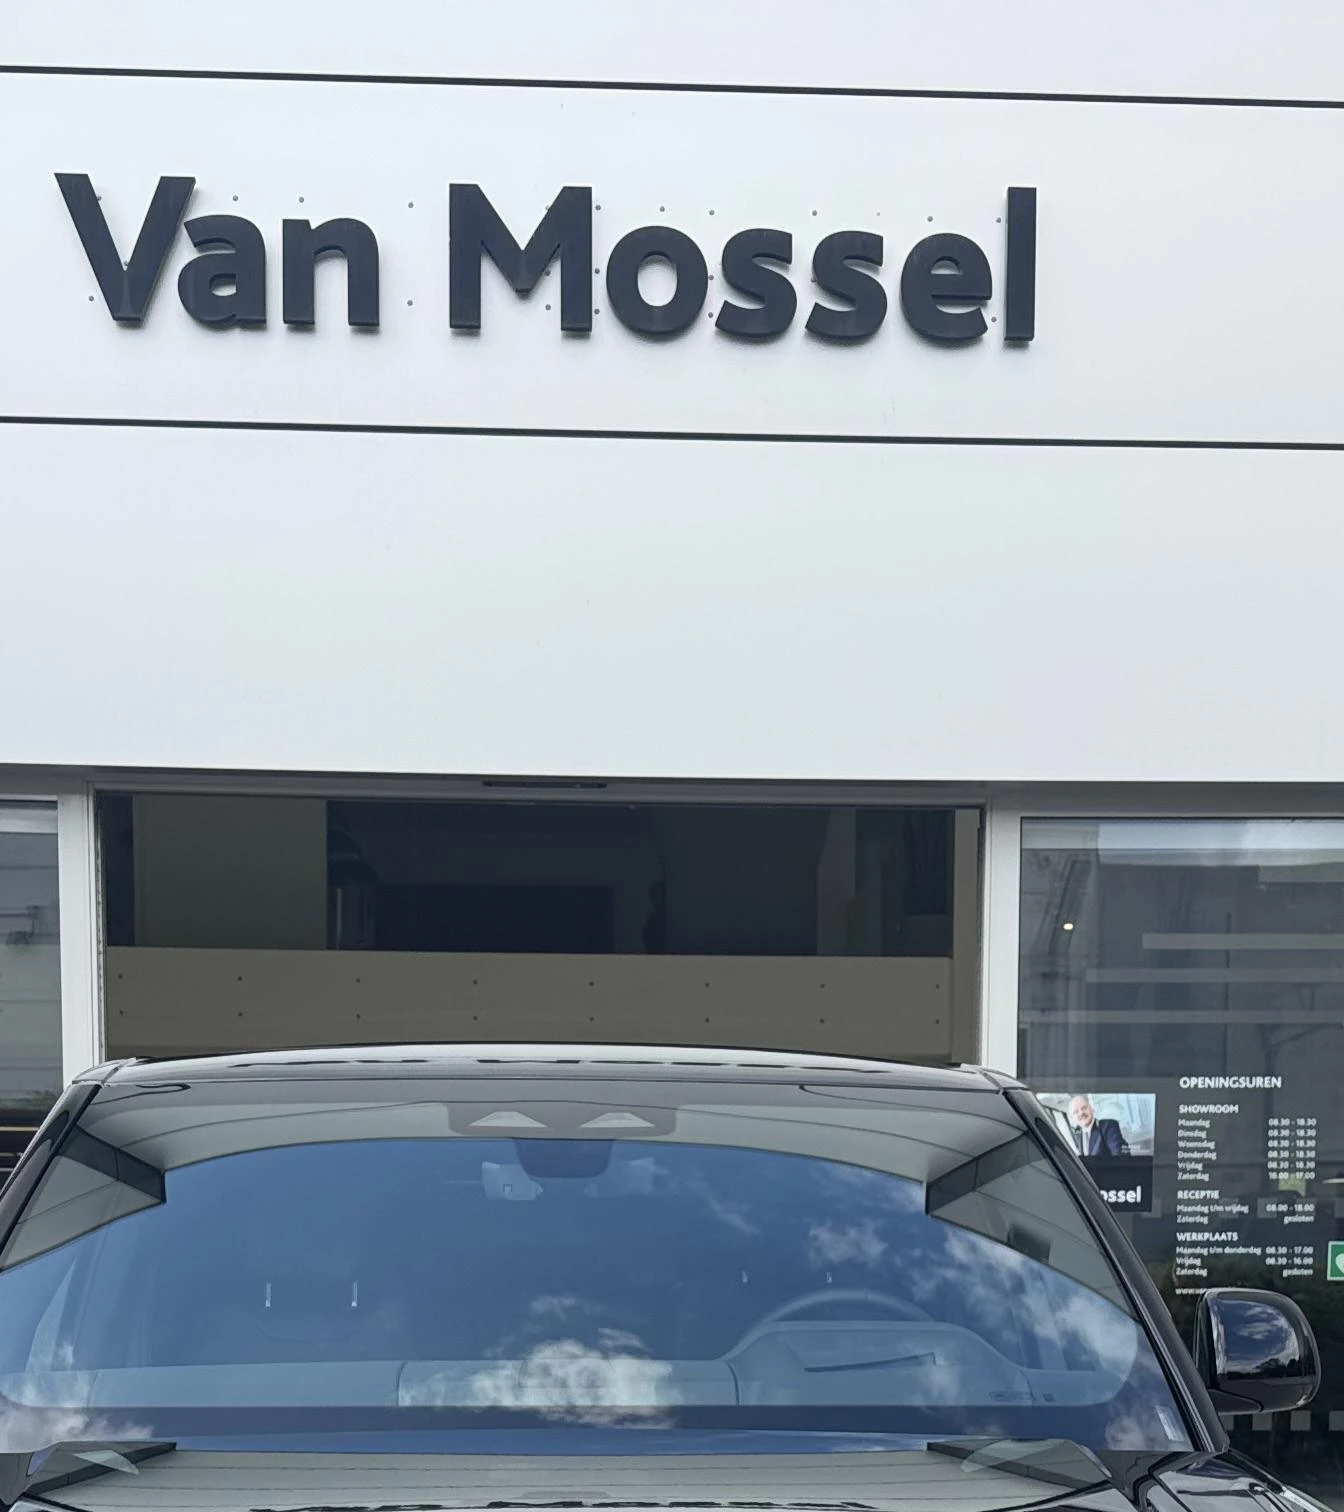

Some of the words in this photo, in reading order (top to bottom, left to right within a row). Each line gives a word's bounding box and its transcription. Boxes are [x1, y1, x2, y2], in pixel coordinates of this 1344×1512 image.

[55, 172, 380, 332] Van
[448, 181, 1038, 343] Mossel
[1179, 1076, 1282, 1089] OPENINGSUREN
[1178, 1104, 1239, 1114] SHOWROOM
[1099, 1185, 1142, 1203] ossel
[1177, 1190, 1220, 1200] RECEPTIE
[1176, 1232, 1239, 1241] WERKPLAATS
